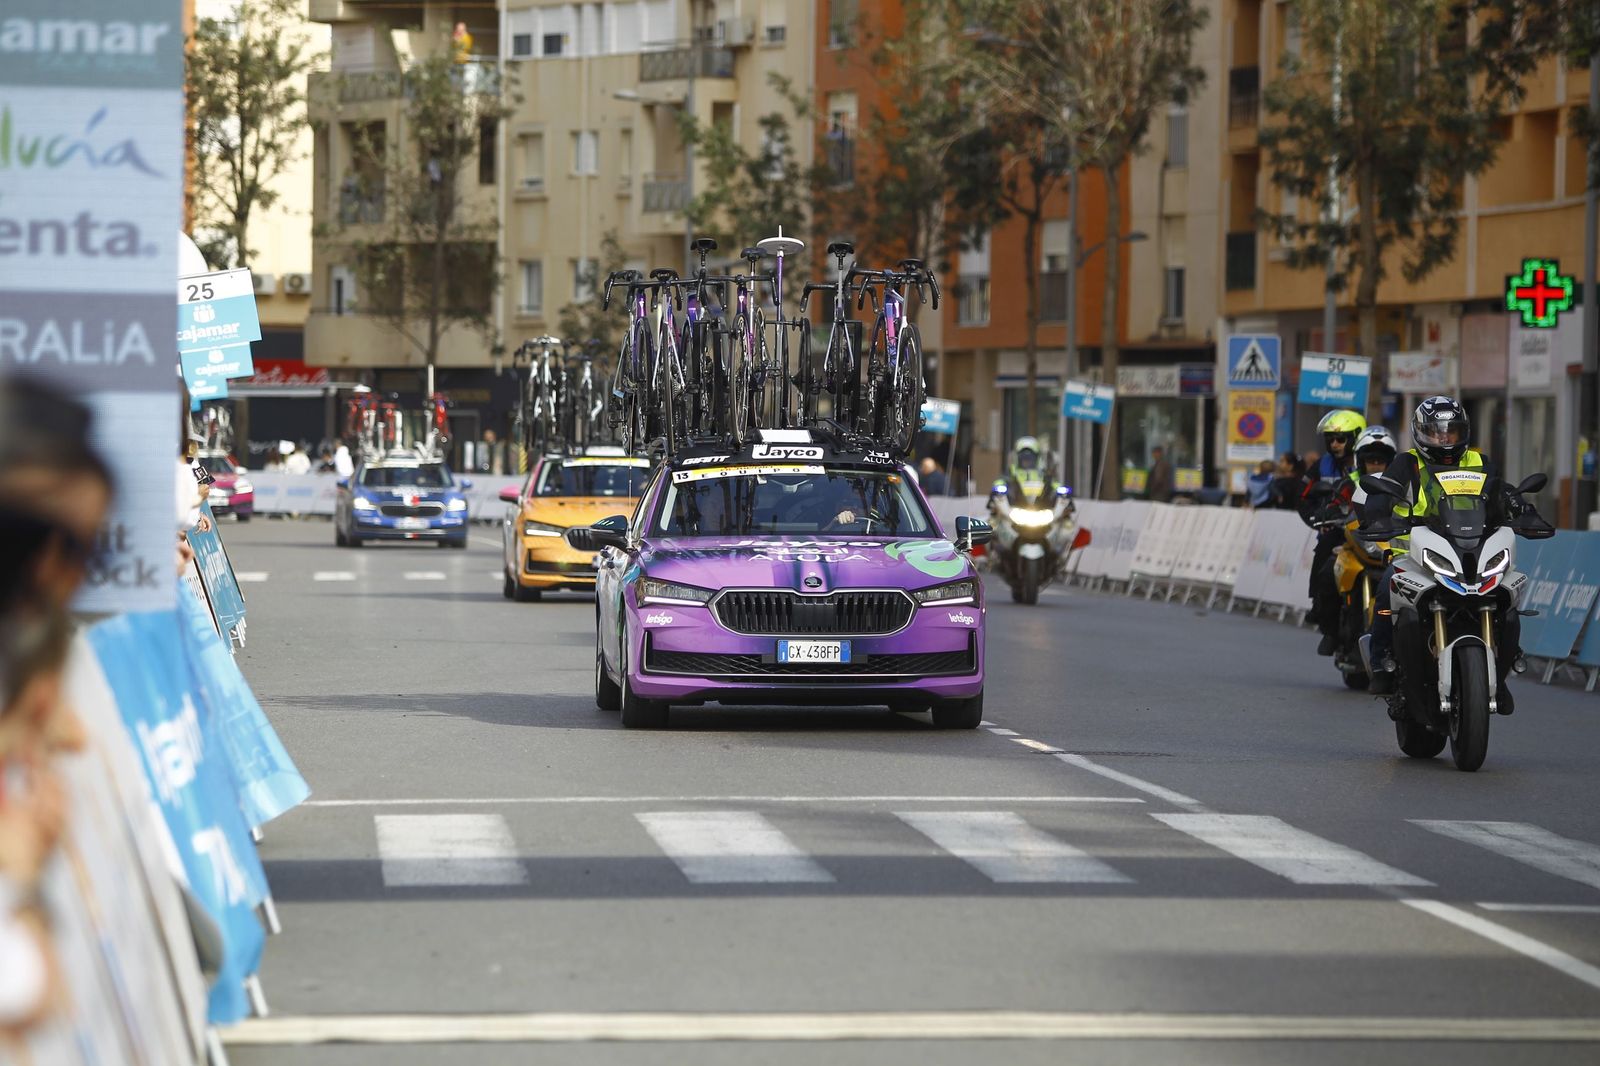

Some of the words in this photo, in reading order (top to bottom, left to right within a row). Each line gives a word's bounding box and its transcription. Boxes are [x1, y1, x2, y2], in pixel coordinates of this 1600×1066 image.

[187, 282, 214, 302] 25
[1328, 358, 1346, 373] 50
[758, 444, 818, 459] Jayco
[863, 456, 894, 465] ALULA
[676, 472, 689, 480] 13
[748, 554, 870, 562] ALULA
